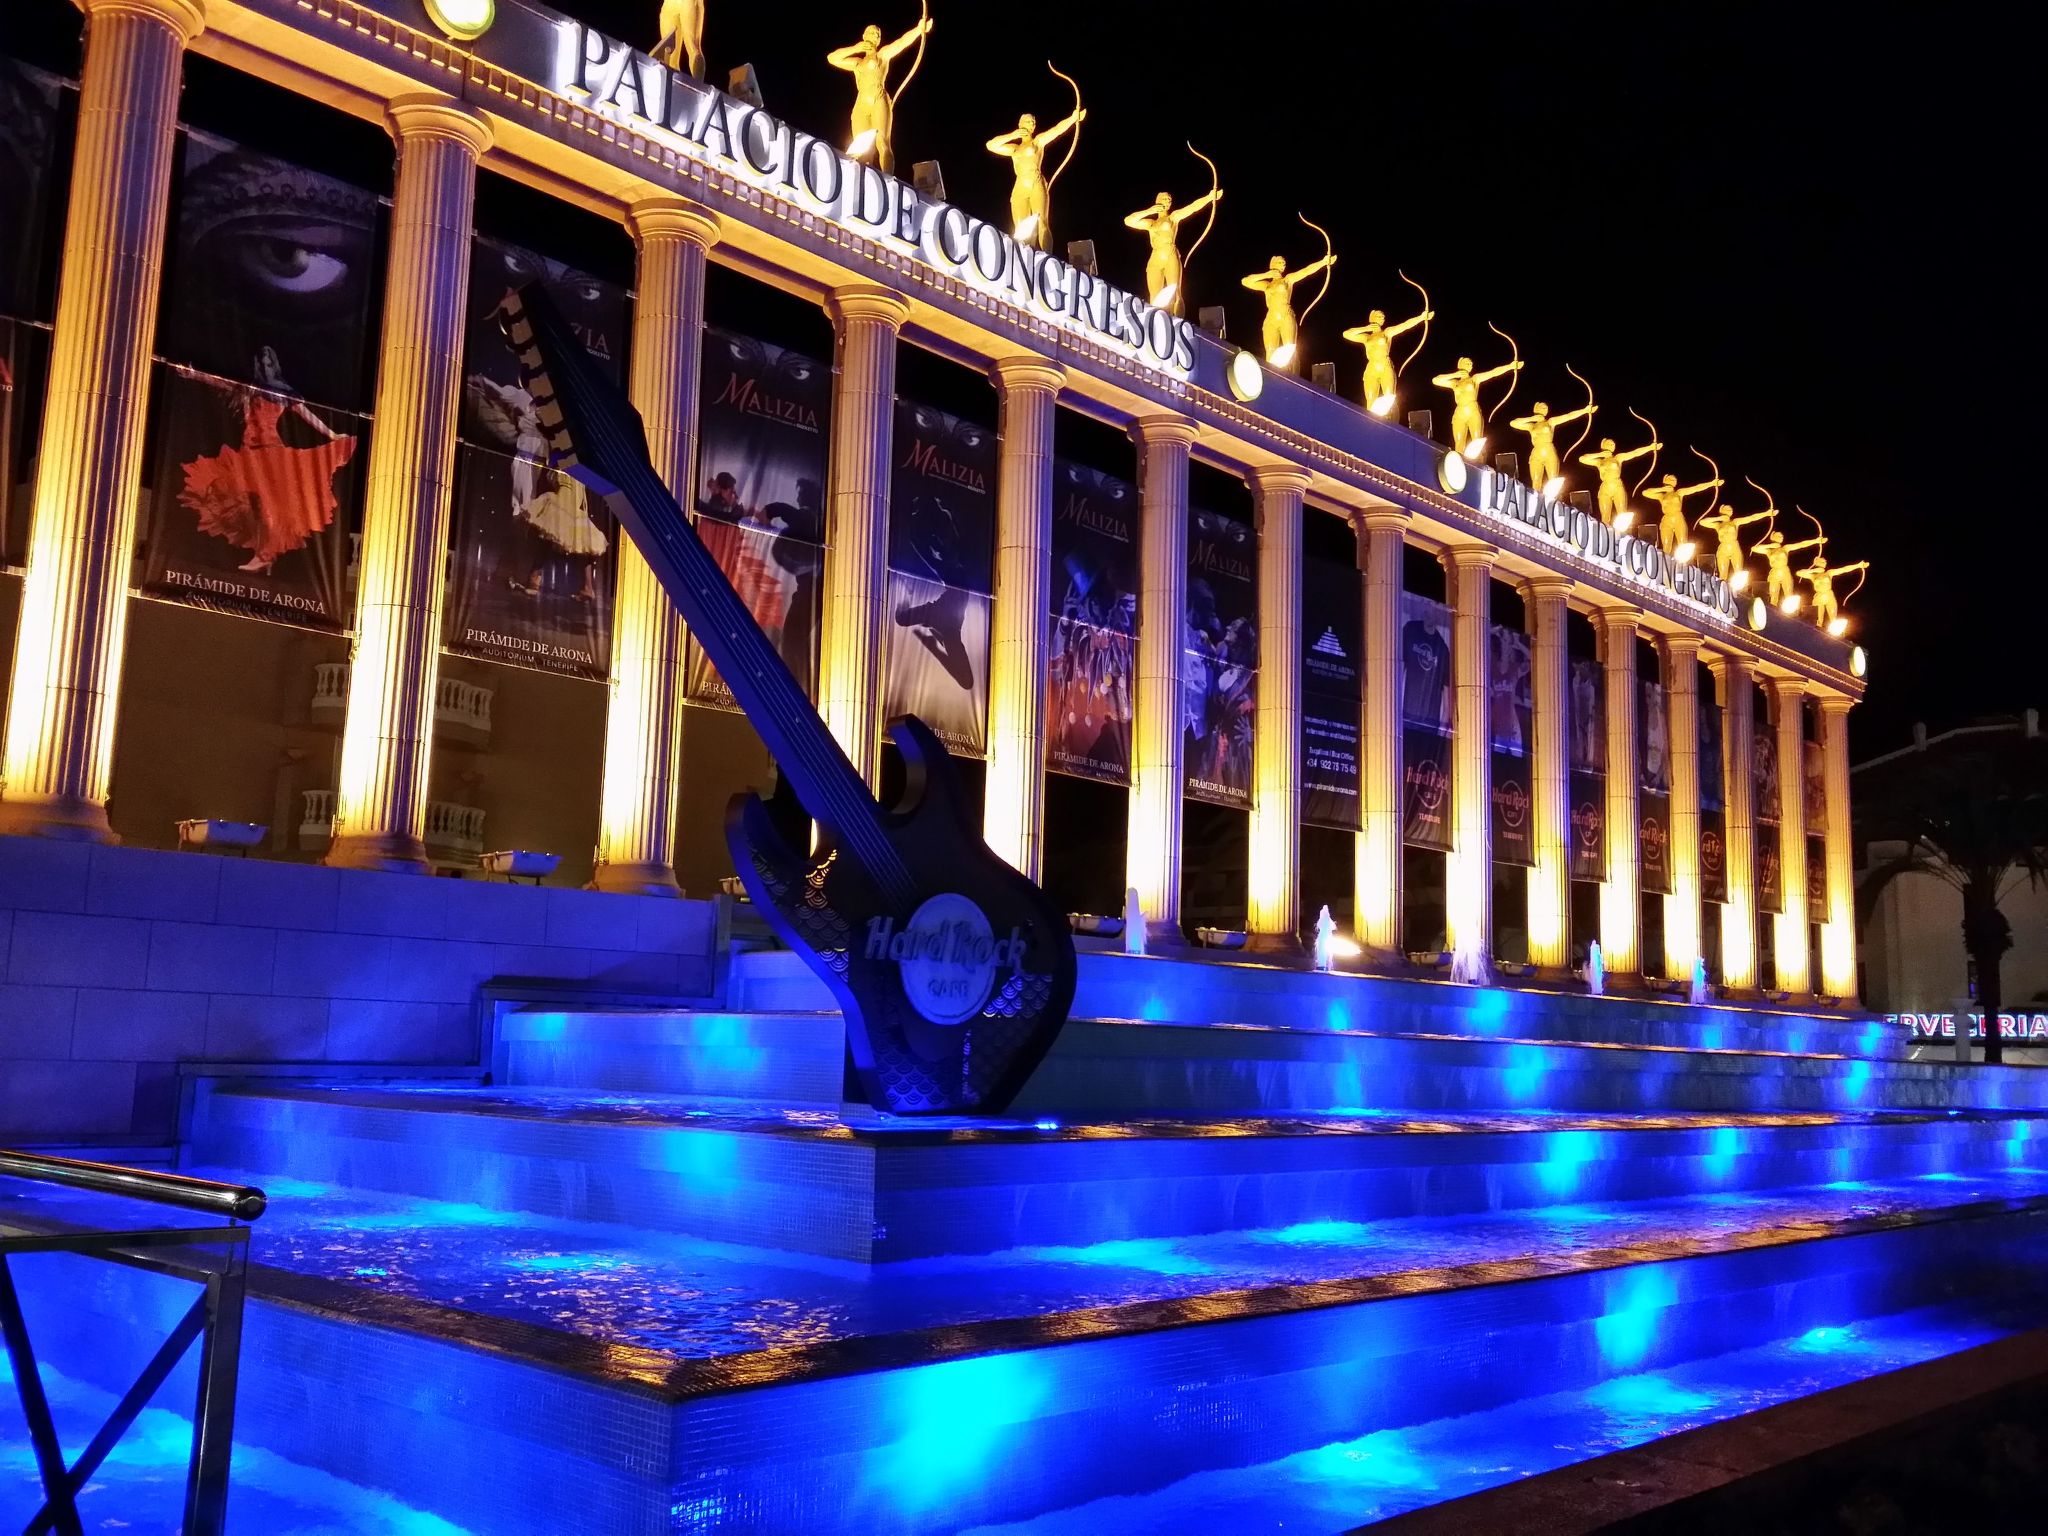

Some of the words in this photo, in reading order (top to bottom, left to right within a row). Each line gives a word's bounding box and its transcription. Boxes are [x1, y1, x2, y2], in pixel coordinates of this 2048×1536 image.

[570, 18, 843, 204] PALACIO
[853, 163, 922, 246] DE
[938, 206, 1195, 372] CONGRESOS
[712, 372, 818, 428] MALIZIA
[902, 438, 985, 489] MALIZIA
[1059, 493, 1128, 537] MALIZIA
[1491, 472, 1590, 549] PALACIO
[1593, 521, 1622, 565] DE
[1626, 538, 1739, 619] CONGRESOS
[166, 570, 246, 598] PIRÁMIDE
[249, 587, 270, 603] DE
[273, 593, 326, 615] ARONA
[466, 629, 530, 651] PIRÁMIDE
[532, 641, 549, 654] DE
[550, 645, 593, 664] ARONA
[482, 648, 535, 662] AUDITORIUM
[542, 660, 579, 672] TENERIFE
[934, 728, 946, 739] DE
[946, 731, 976, 746] ARONA
[1100, 761, 1125, 774] ARONA
[1320, 759, 1331, 770] 922
[1189, 778, 1219, 791] PIRÁMIDE
[1219, 784, 1228, 794] DE
[1228, 787, 1248, 799] ARONA
[865, 915, 951, 966] Hard
[951, 918, 1028, 976] Rock
